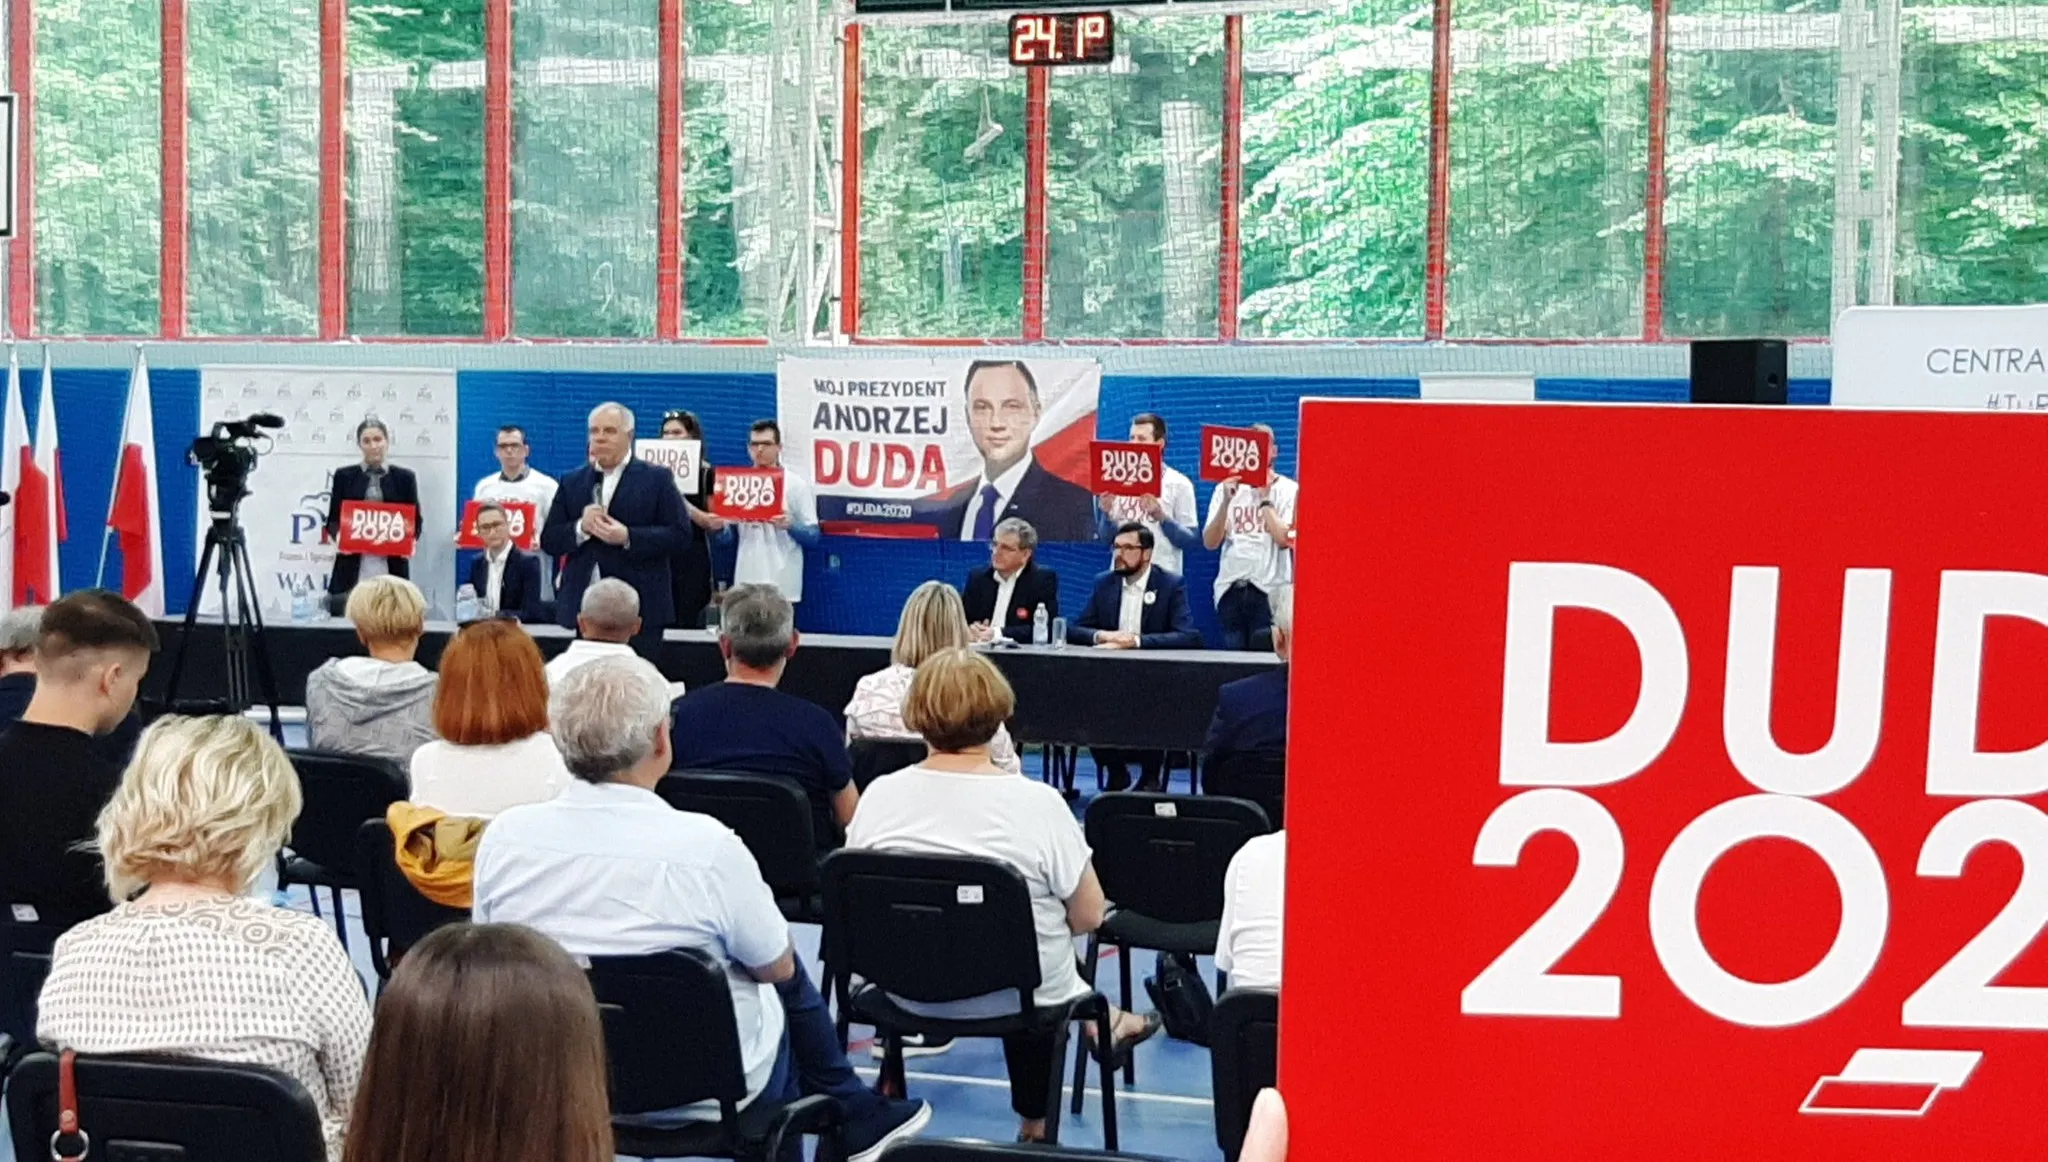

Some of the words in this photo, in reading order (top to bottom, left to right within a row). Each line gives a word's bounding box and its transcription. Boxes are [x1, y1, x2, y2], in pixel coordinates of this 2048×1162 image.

[1927, 348, 2045, 374] CENTRA
[848, 381, 947, 397] PREZYDENT
[813, 402, 948, 434] ANDRZEJ
[1212, 435, 1259, 454] DUDA
[814, 439, 947, 489] DUDA
[1102, 450, 1152, 467] DUDA
[1210, 453, 1260, 471] 2020
[726, 475, 775, 491] DUDA
[1102, 466, 1153, 482] 2020
[723, 489, 775, 506] 2020
[352, 509, 404, 527] DUDA
[350, 525, 405, 543] 2020
[1461, 787, 2048, 1028] 202
